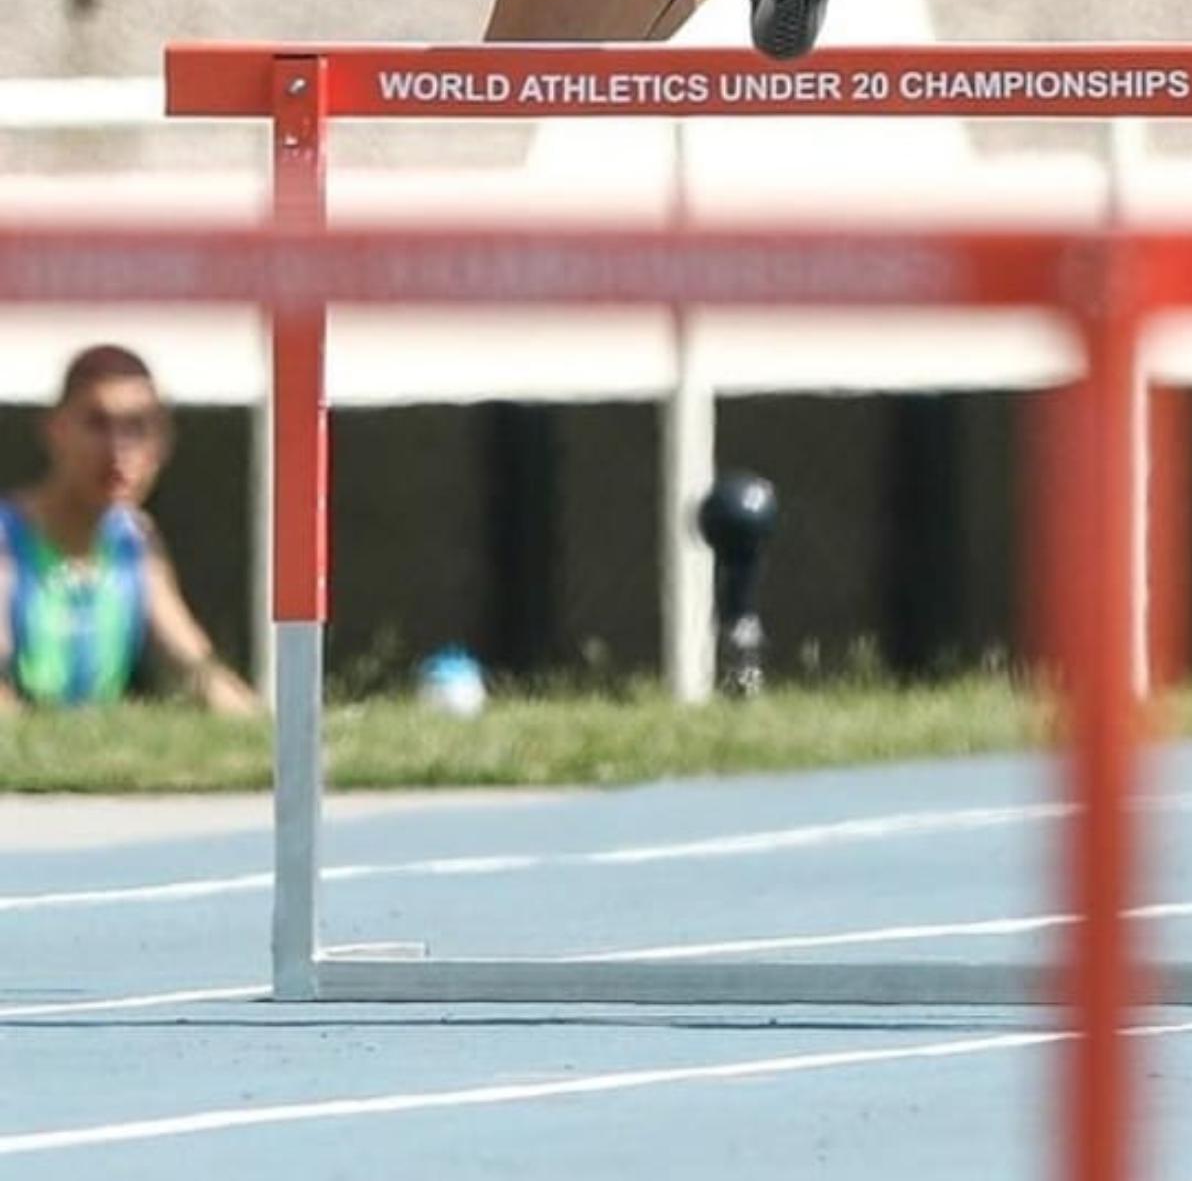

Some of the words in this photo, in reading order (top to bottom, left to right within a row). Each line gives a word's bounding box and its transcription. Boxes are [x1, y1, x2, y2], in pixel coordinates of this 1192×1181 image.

[379, 71, 511, 101] WORLD
[519, 73, 709, 103] ATHLETICS
[719, 72, 842, 102] UNDER
[852, 72, 888, 99] 20
[899, 70, 1190, 99] CHAMPIONSHIPS
